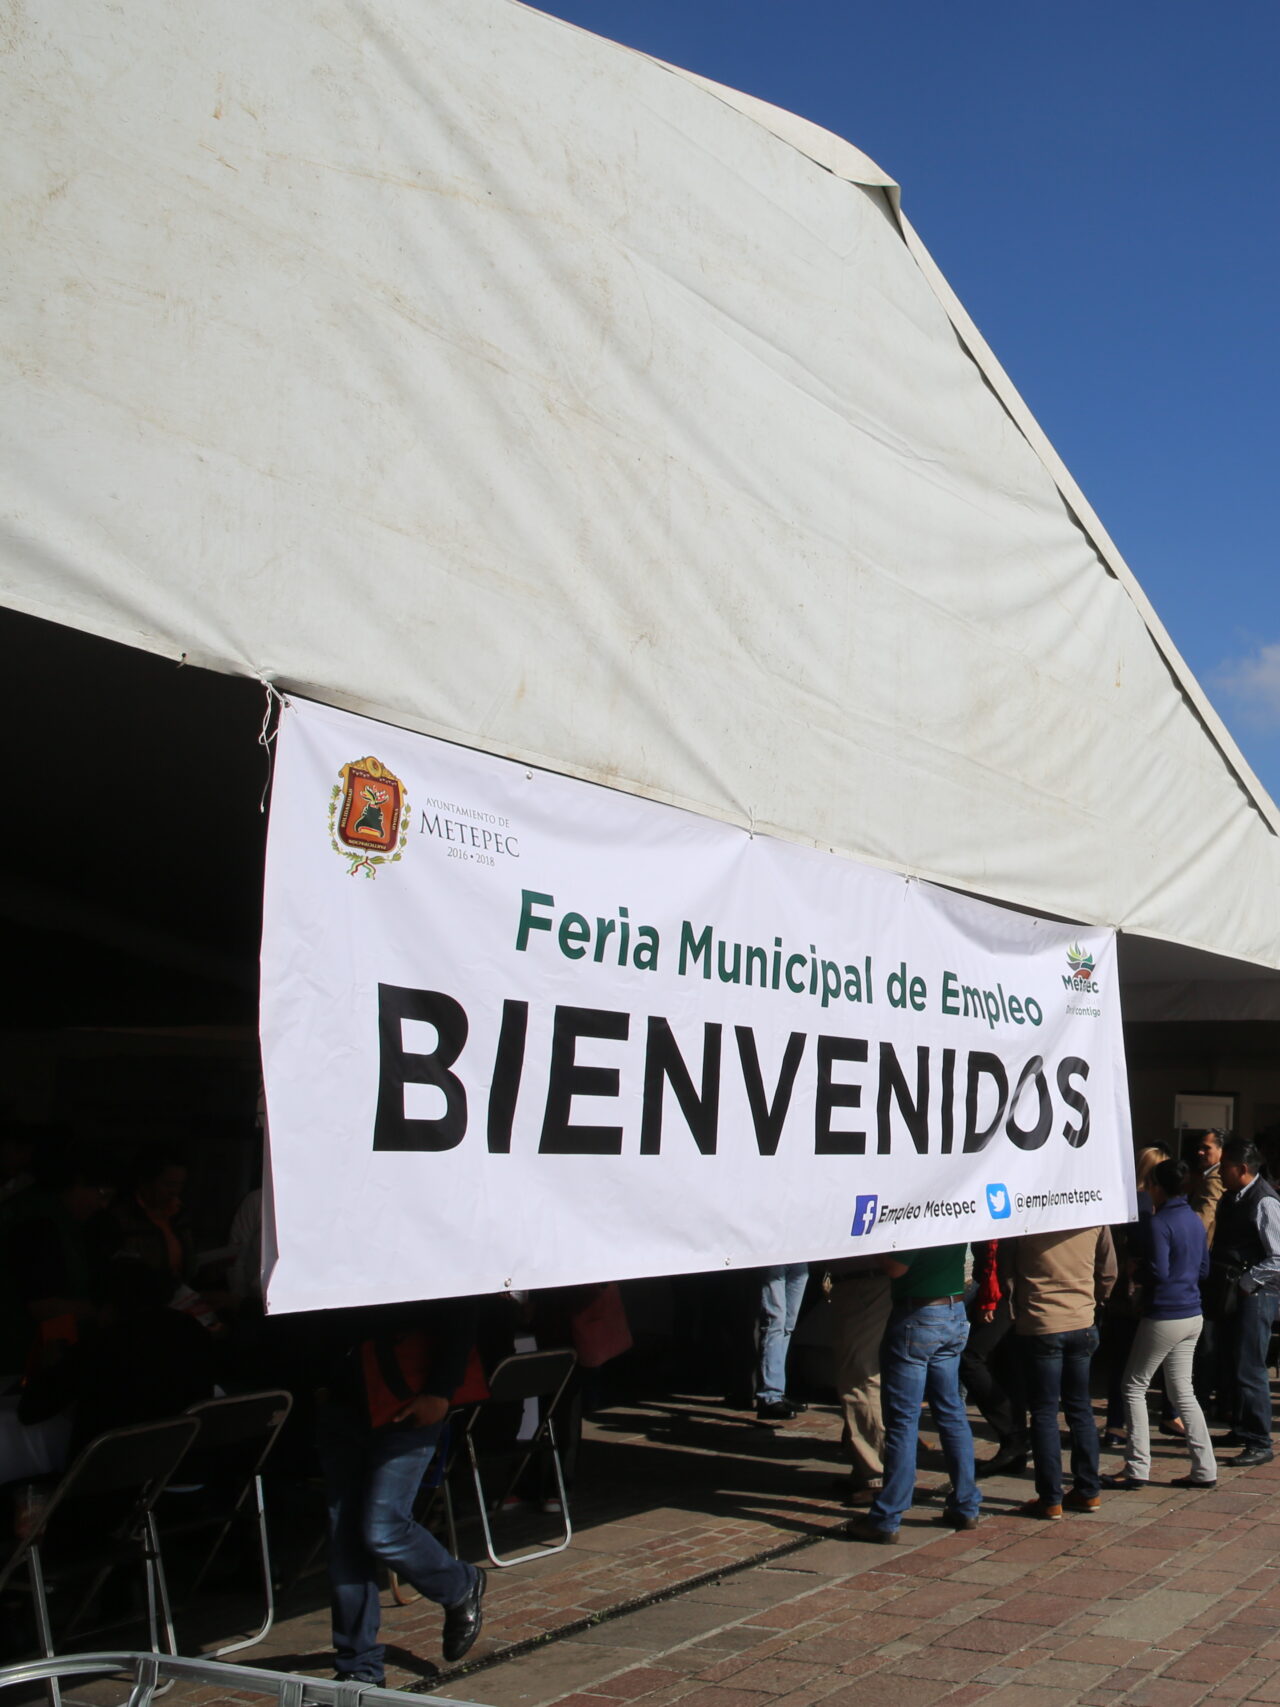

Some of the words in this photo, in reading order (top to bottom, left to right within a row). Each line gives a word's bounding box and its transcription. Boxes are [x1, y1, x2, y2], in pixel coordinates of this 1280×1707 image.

[426, 797, 496, 824] AYUNTAMIENTO
[498, 817, 510, 829] DE
[419, 809, 520, 858] METEPEC
[447, 846, 468, 861] 2016
[476, 852, 496, 867] 2018
[515, 888, 660, 972] Feria
[678, 920, 873, 1008] Municipal
[887, 961, 927, 1012] de
[942, 970, 1043, 1030] Empleo
[372, 982, 1091, 1156] BIENVENIDOS
[878, 1202, 921, 1224] Empleo
[924, 1200, 977, 1219] Metepec
[1015, 1188, 1103, 1213] @empleometepec
